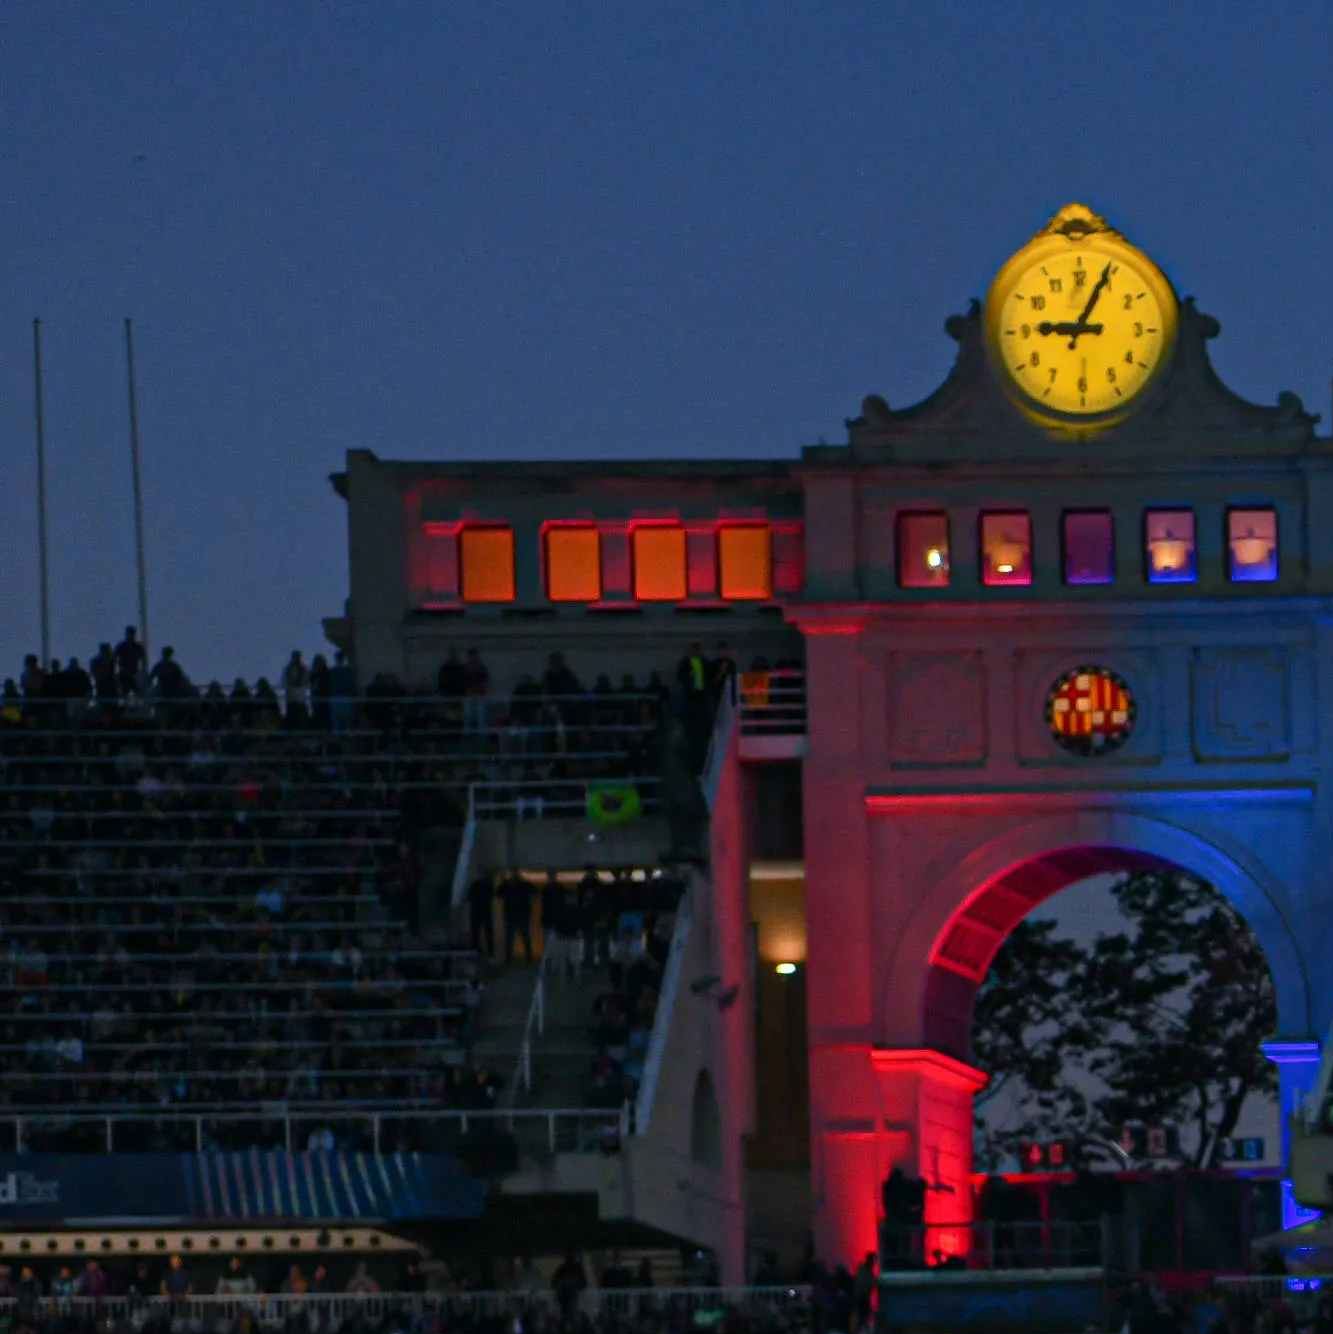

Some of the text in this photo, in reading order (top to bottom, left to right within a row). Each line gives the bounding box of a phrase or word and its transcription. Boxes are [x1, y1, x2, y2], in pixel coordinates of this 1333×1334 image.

[1030, 295, 1046, 311] 10
[1123, 294, 1133, 310] 2
[1021, 324, 1031, 339] 9
[1134, 322, 1143, 338] 3
[1125, 351, 1133, 365] 4
[1048, 368, 1057, 383] 7
[1107, 367, 1116, 383] 5
